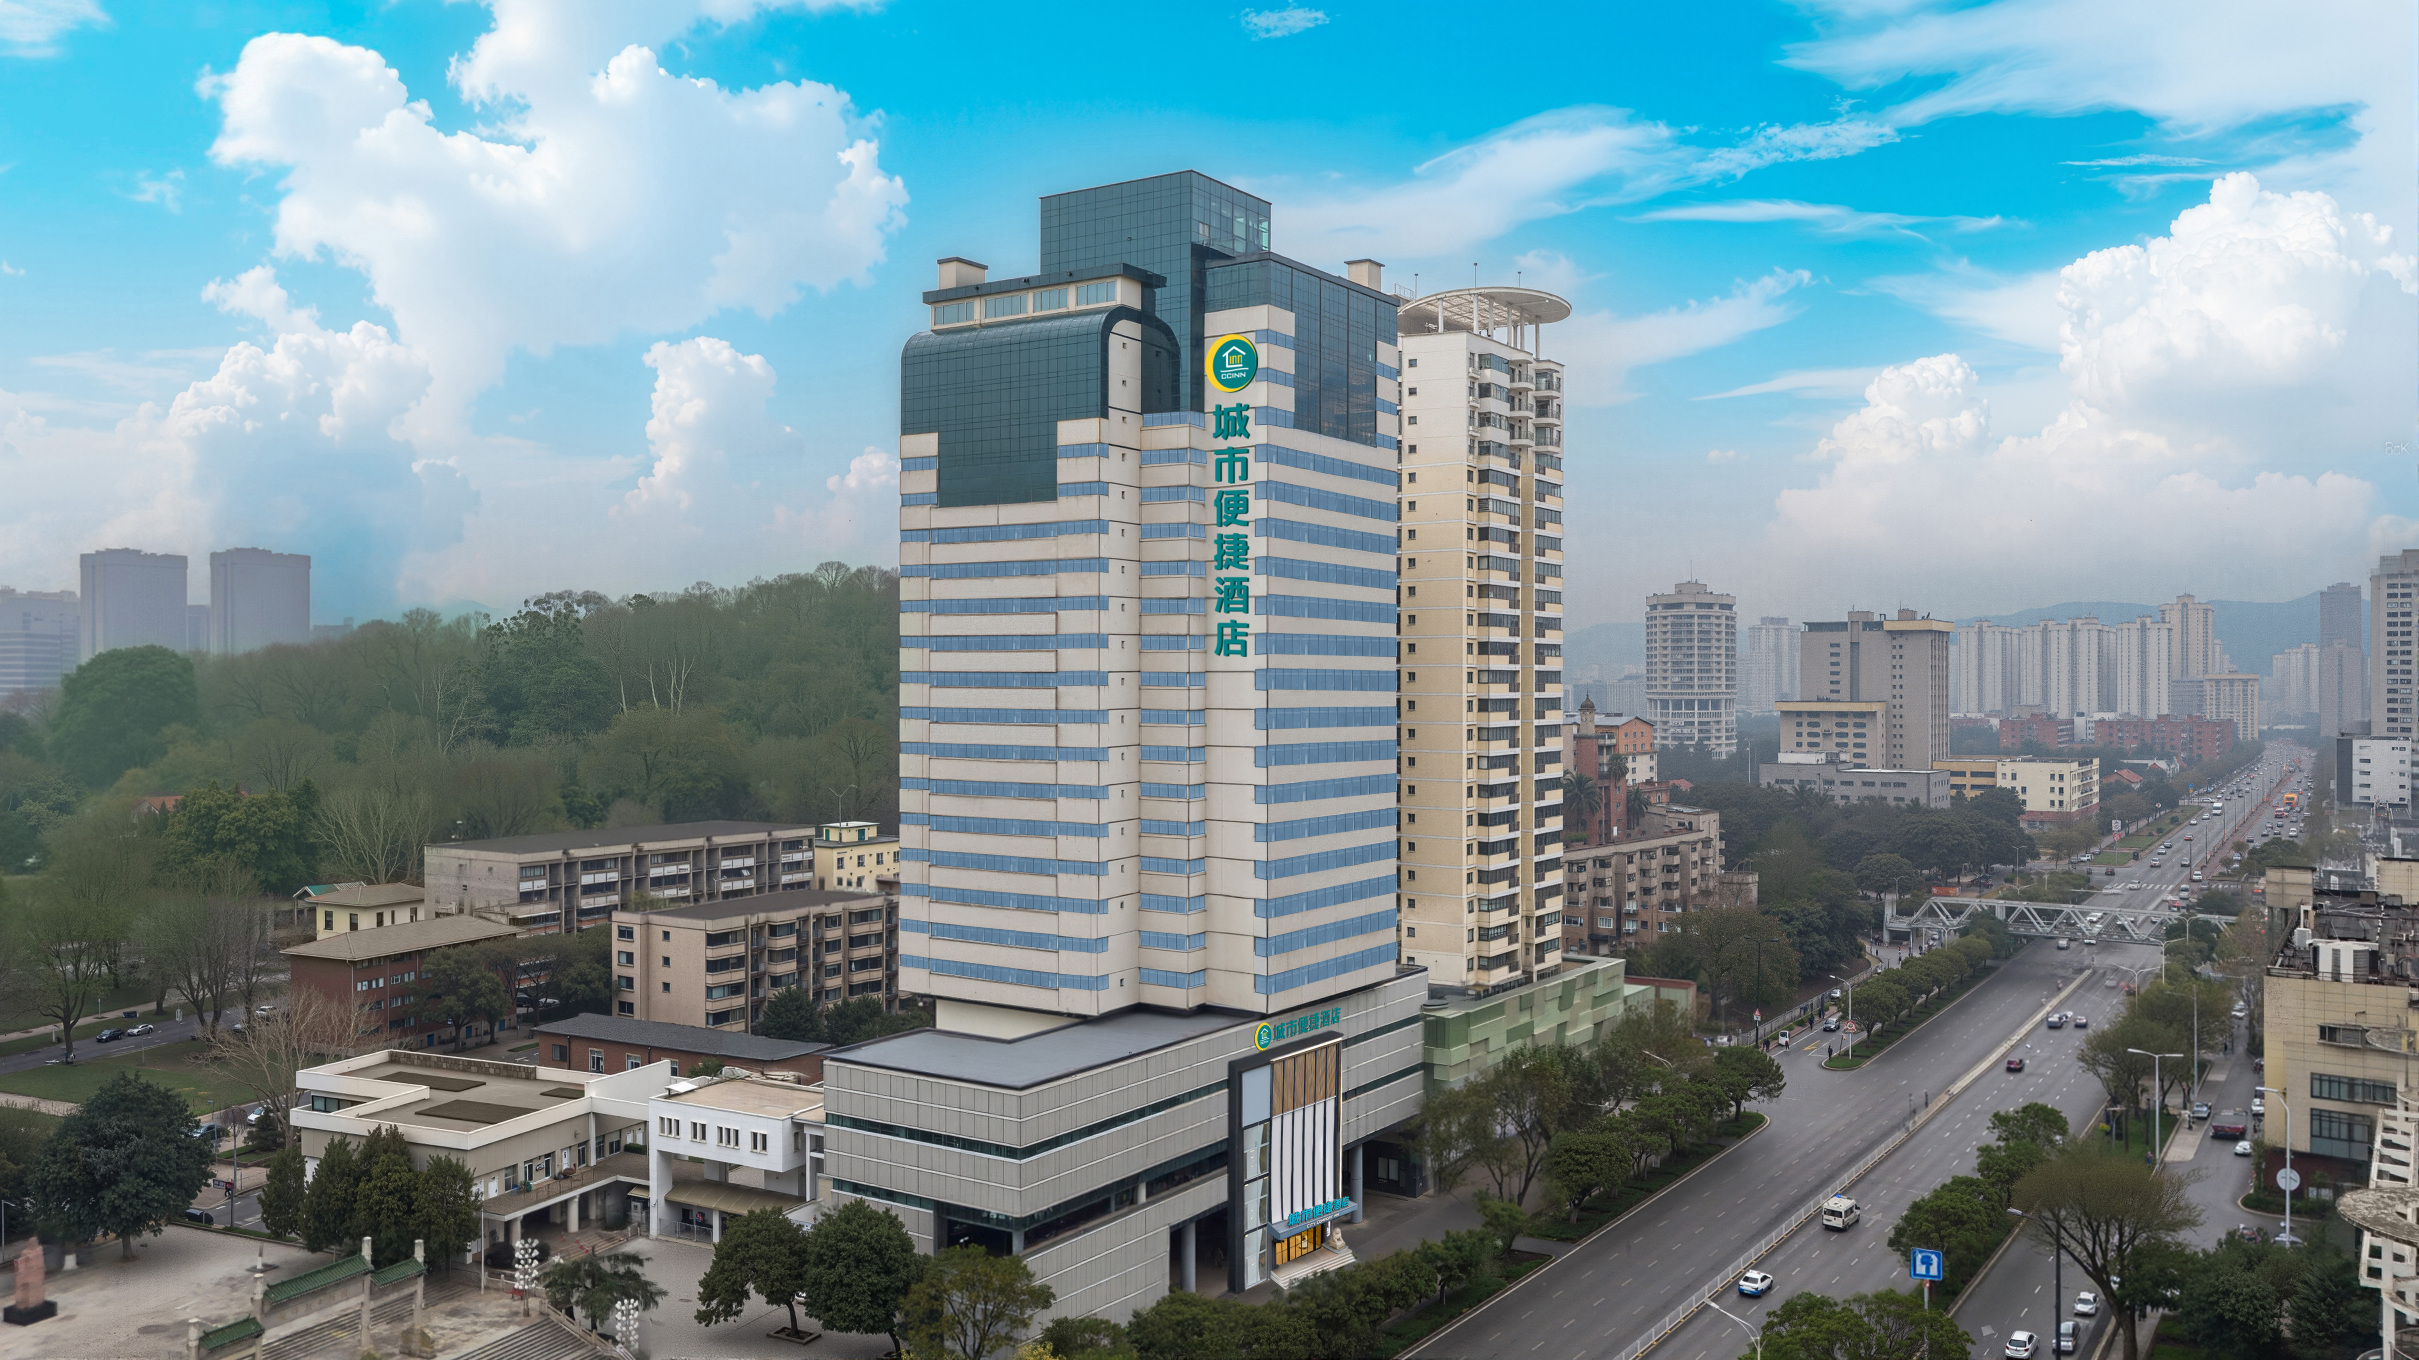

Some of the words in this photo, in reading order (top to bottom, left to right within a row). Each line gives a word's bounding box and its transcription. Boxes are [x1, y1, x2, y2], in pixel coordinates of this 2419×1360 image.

[1221, 372, 1246, 380] CCINN
[1212, 402, 1250, 658] 城市便捷酒店
[1273, 1007, 1341, 1042] 城市便捷酒店
[1288, 1196, 1350, 1227] 城市便捷酒店
